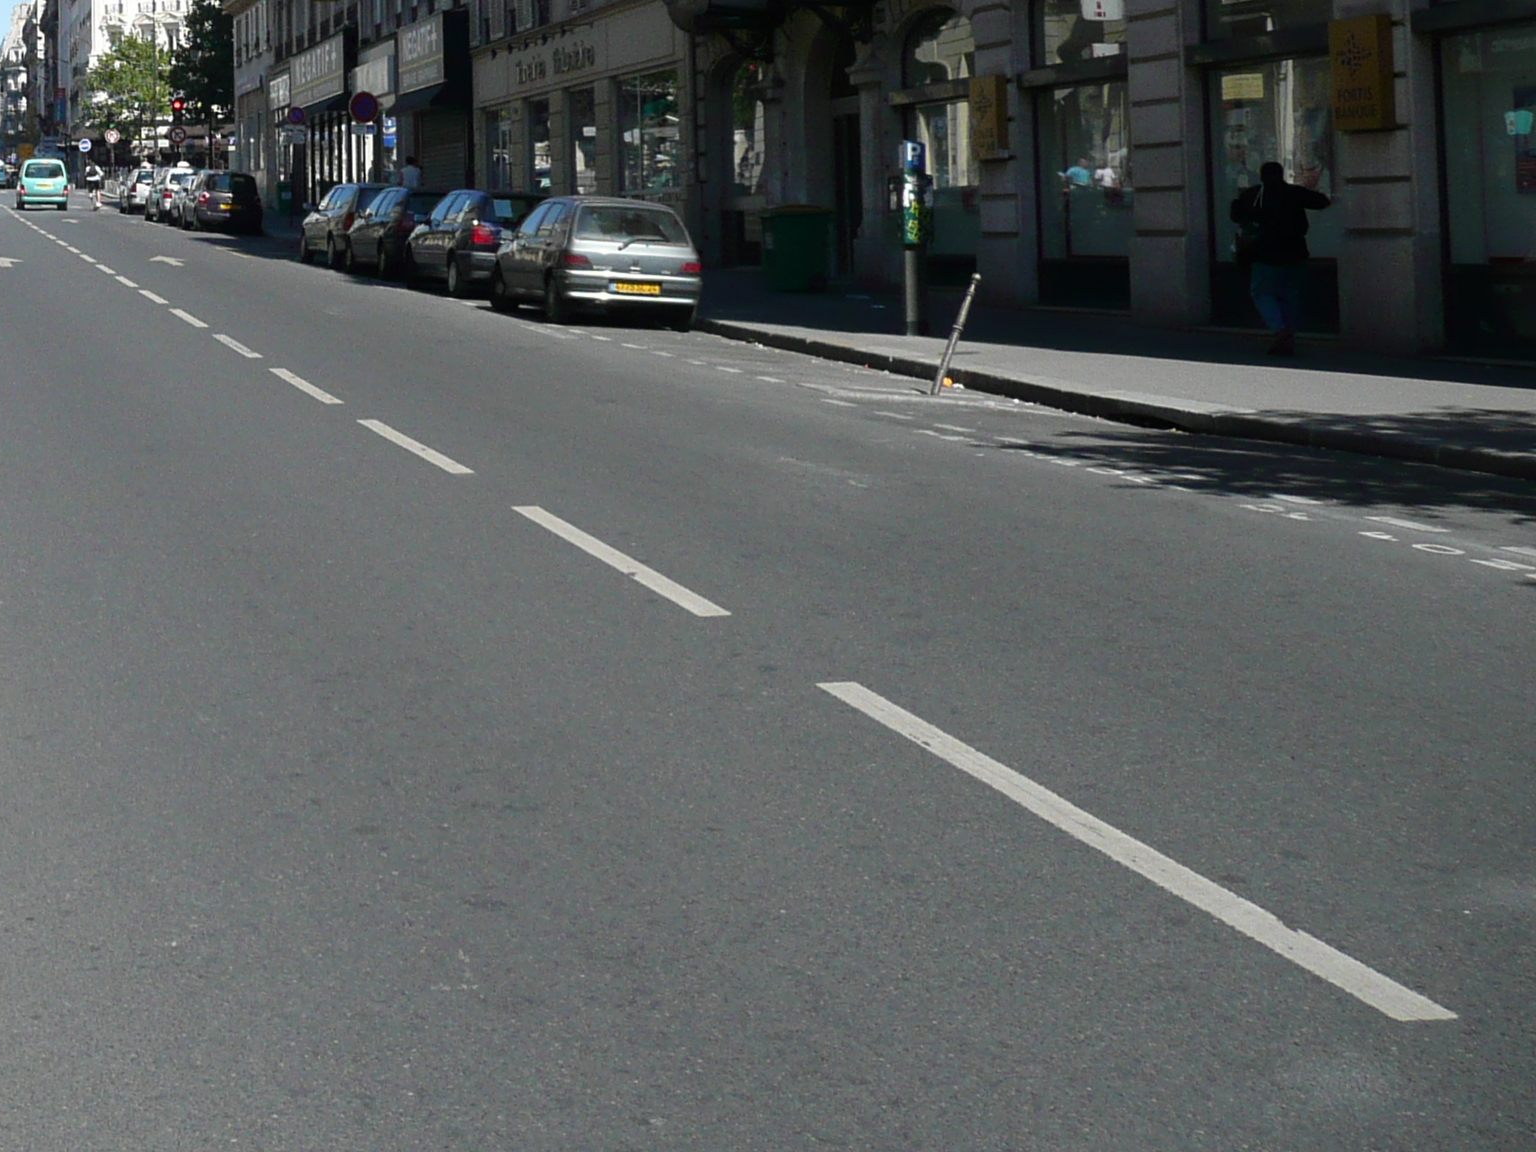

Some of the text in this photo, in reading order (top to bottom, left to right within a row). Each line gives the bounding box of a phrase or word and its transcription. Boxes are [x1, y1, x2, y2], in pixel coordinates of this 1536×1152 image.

[1337, 87, 1374, 104] FORTIS
[1334, 103, 1378, 121] BANQUE
[907, 142, 922, 162] P
